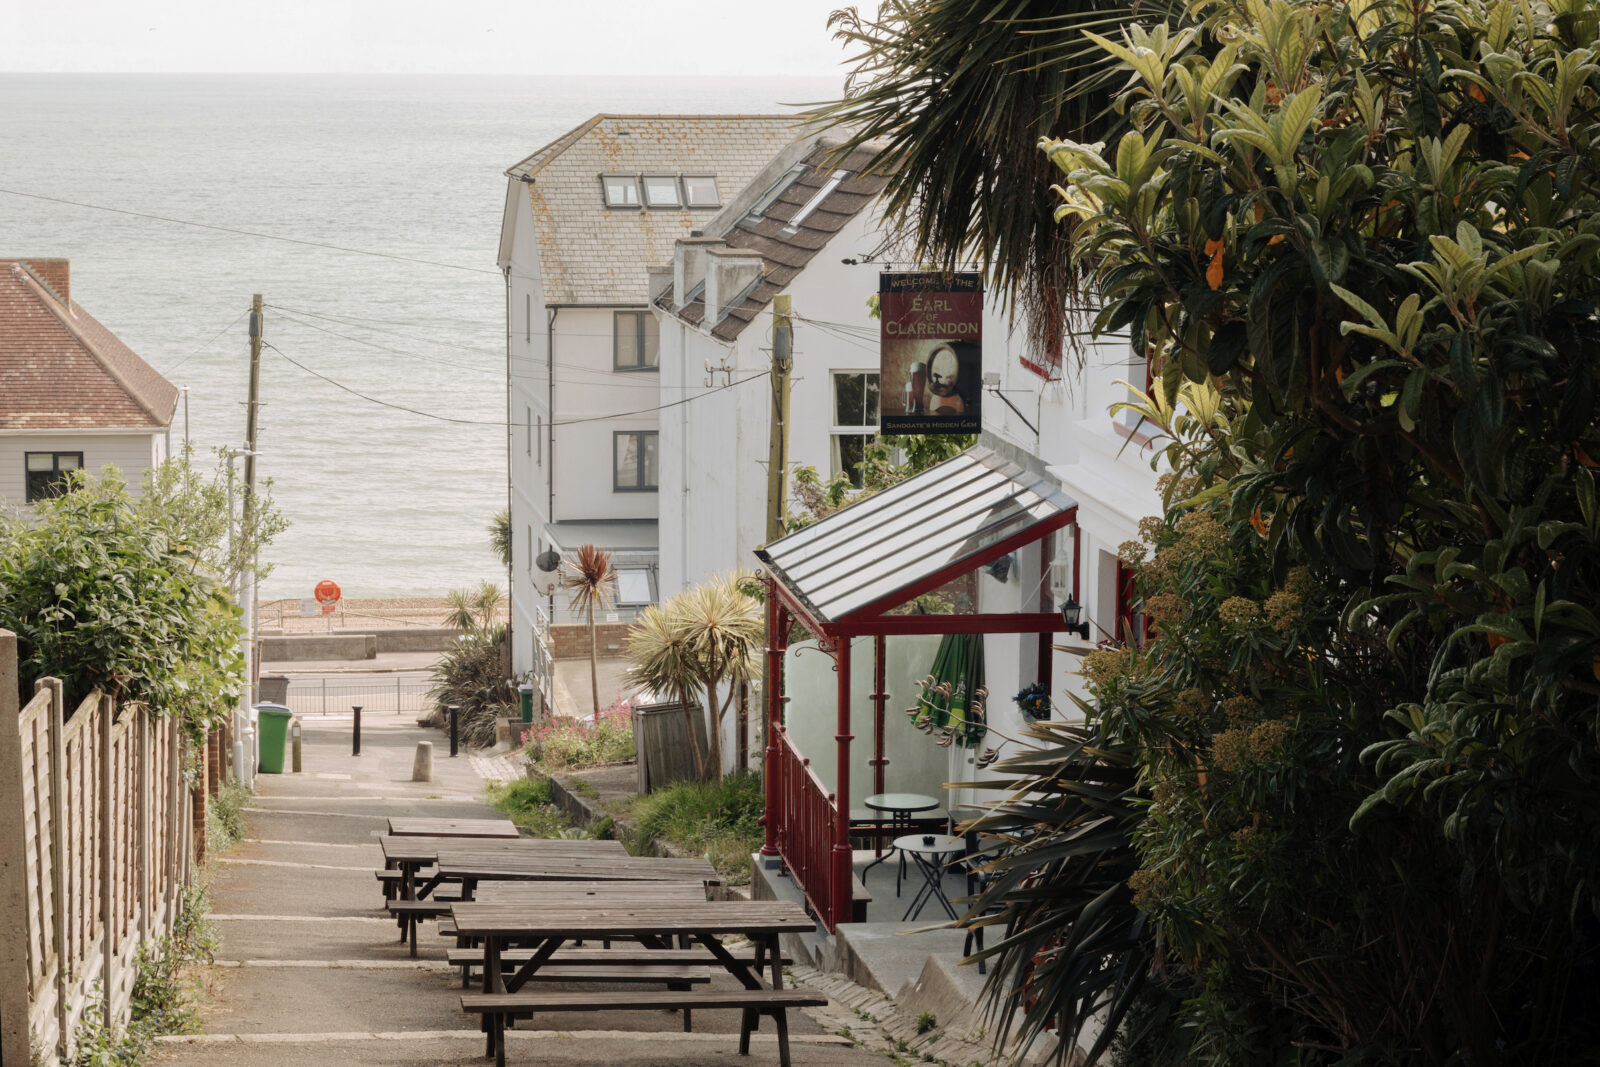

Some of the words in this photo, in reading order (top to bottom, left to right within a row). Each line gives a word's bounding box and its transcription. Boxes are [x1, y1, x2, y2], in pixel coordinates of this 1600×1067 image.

[956, 278, 974, 288] THE
[912, 297, 952, 311] EARL
[926, 313, 939, 321] OF
[886, 321, 978, 334] CLARENDON
